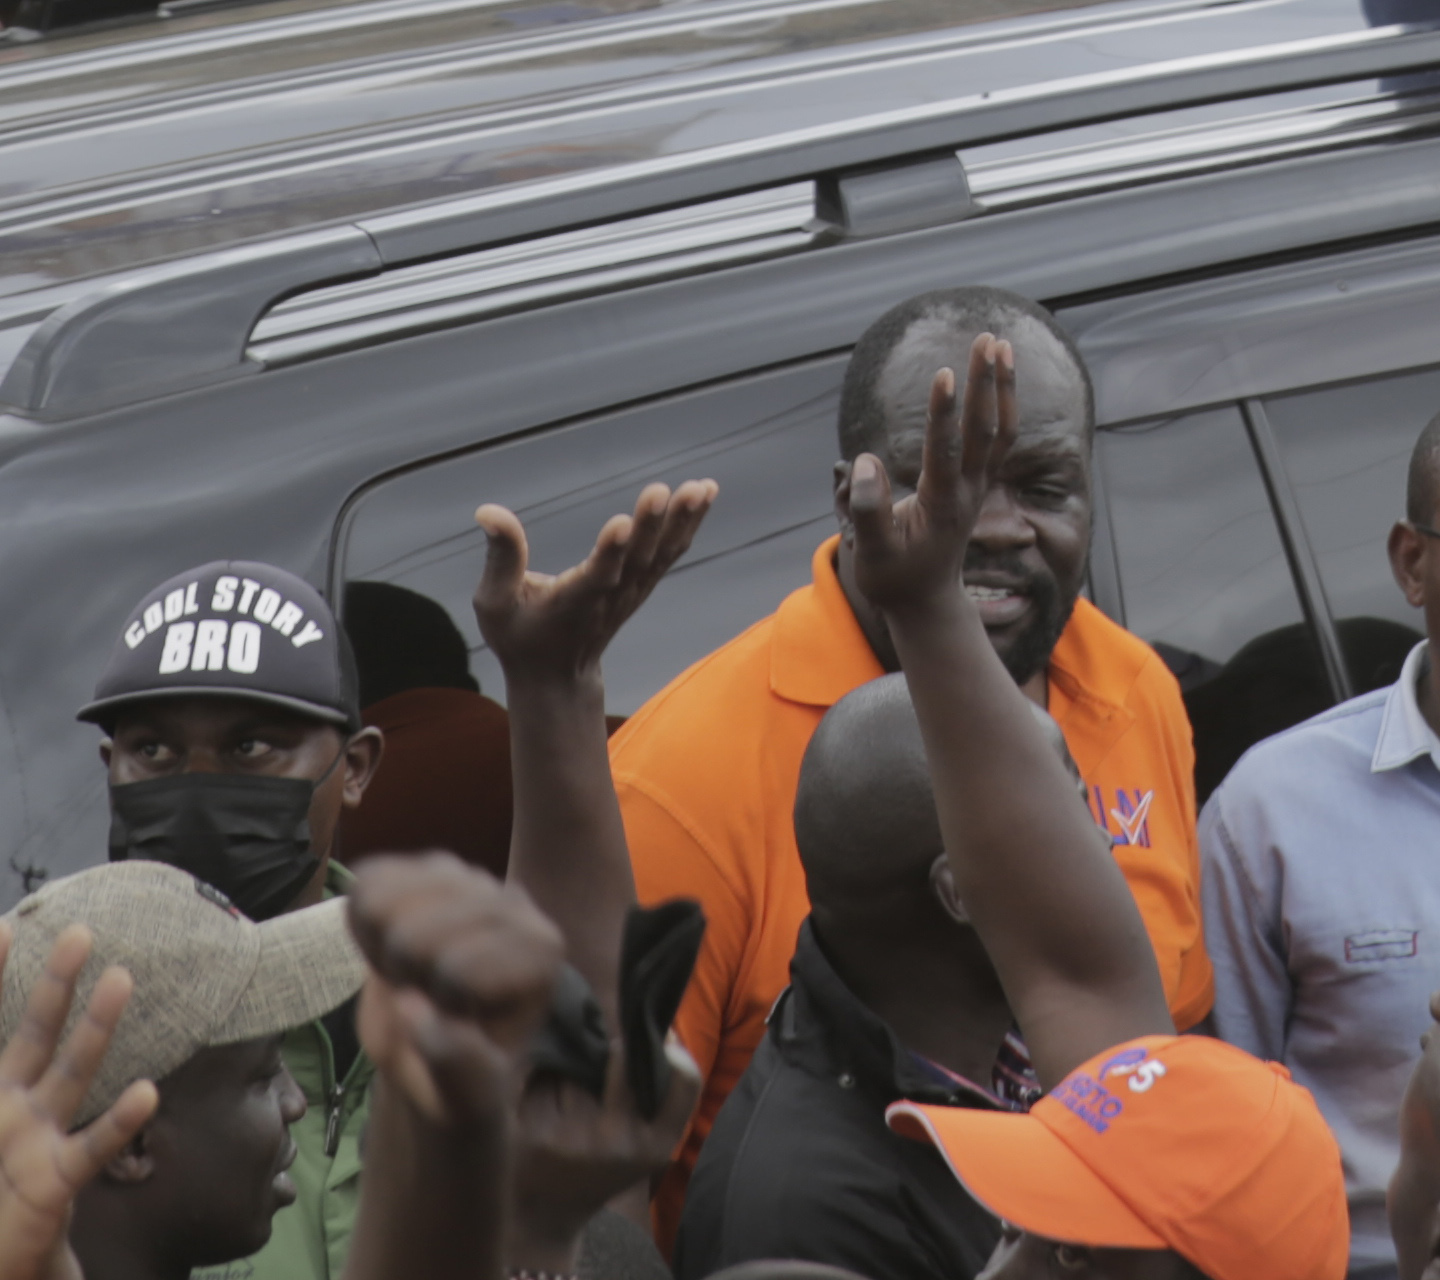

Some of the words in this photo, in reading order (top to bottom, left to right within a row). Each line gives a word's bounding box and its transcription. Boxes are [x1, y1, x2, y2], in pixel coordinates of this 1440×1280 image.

[124, 581, 200, 650] COOL
[211, 575, 324, 648] STORY
[159, 619, 262, 674] BRO
